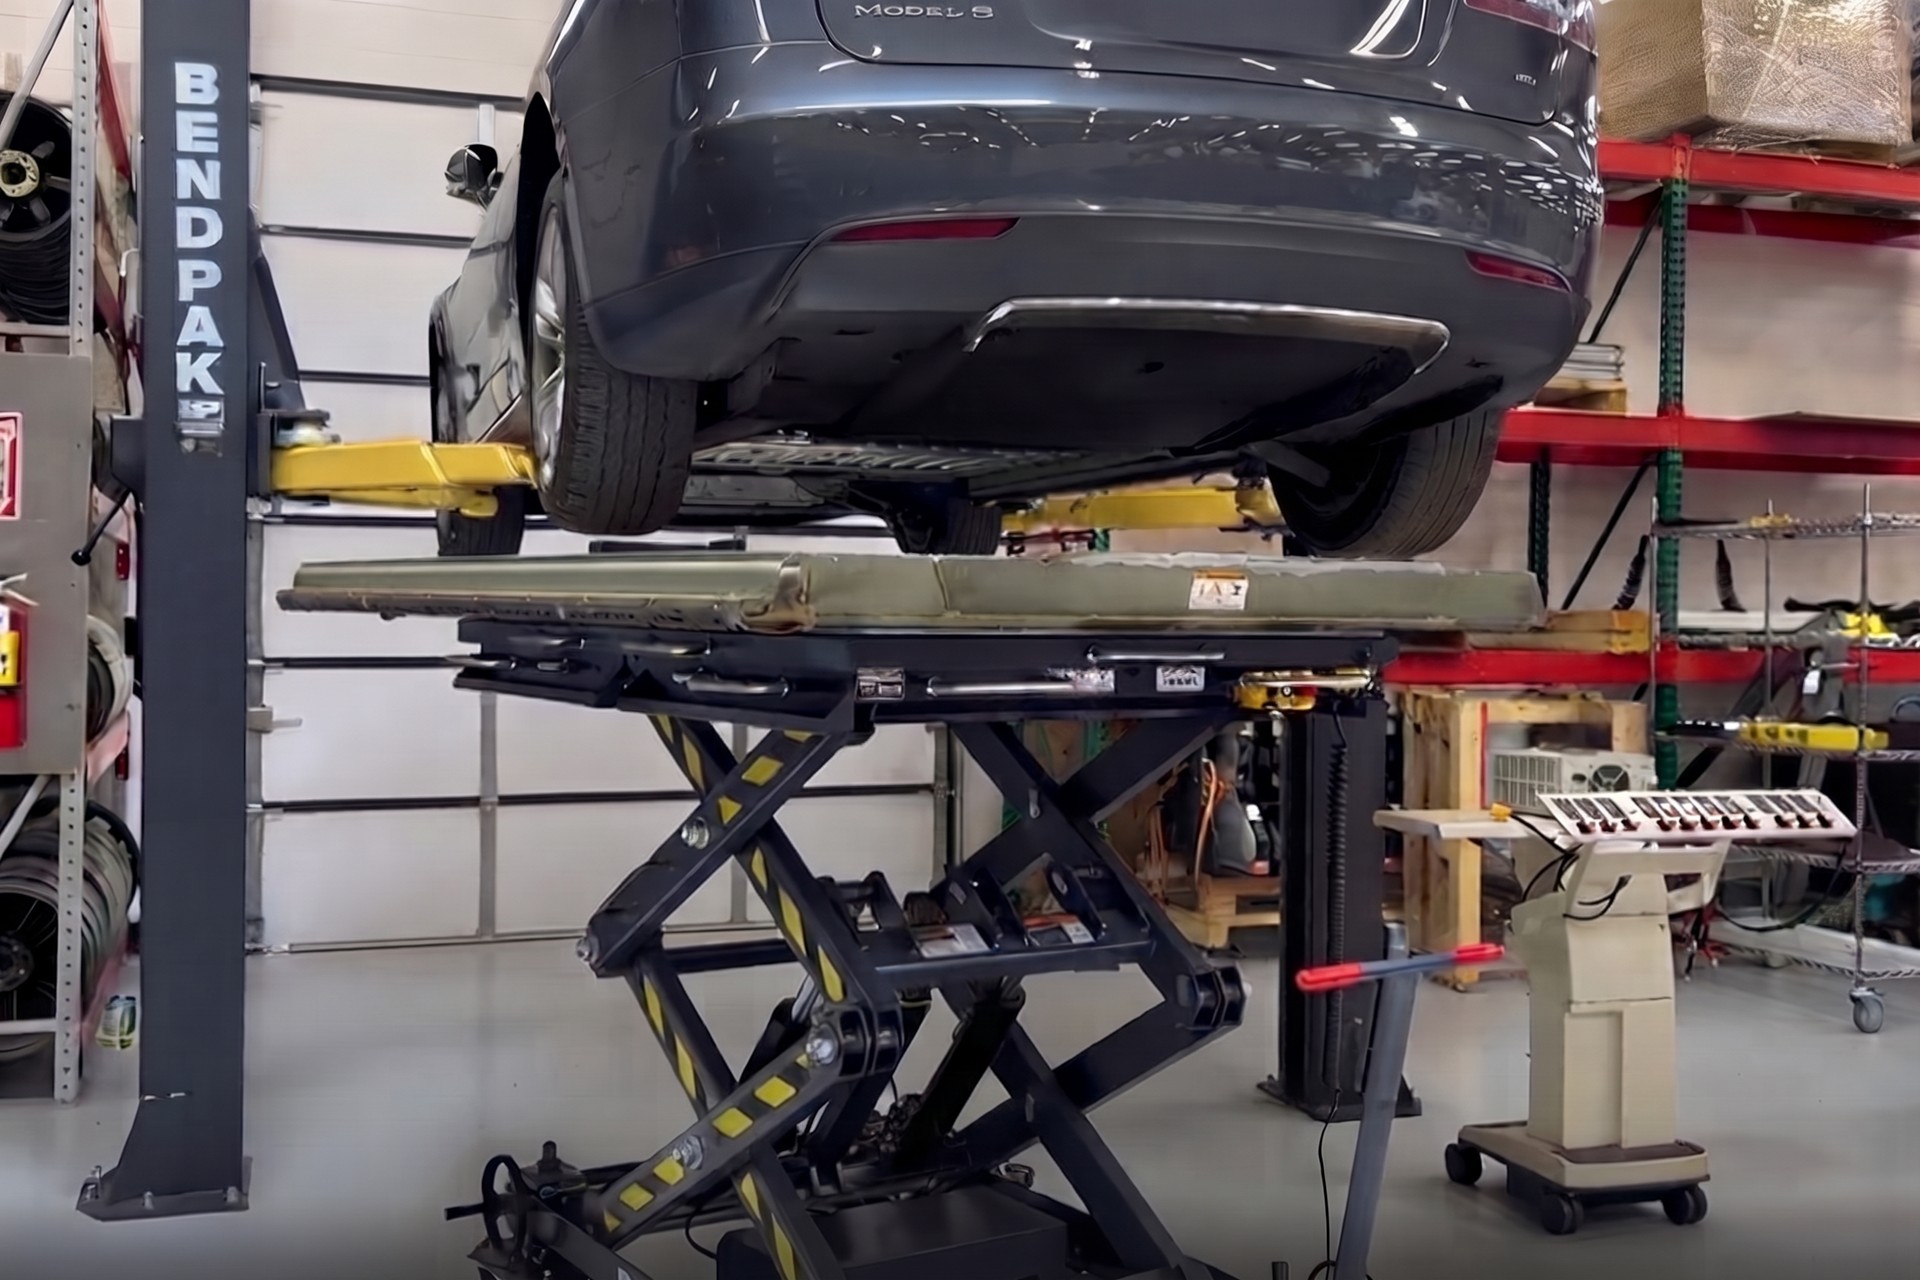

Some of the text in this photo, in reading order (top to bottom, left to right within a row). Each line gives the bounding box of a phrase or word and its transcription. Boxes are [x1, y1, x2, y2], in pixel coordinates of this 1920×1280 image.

[854, 3, 994, 19] MODEL S
[174, 62, 225, 395] BENDPAK
